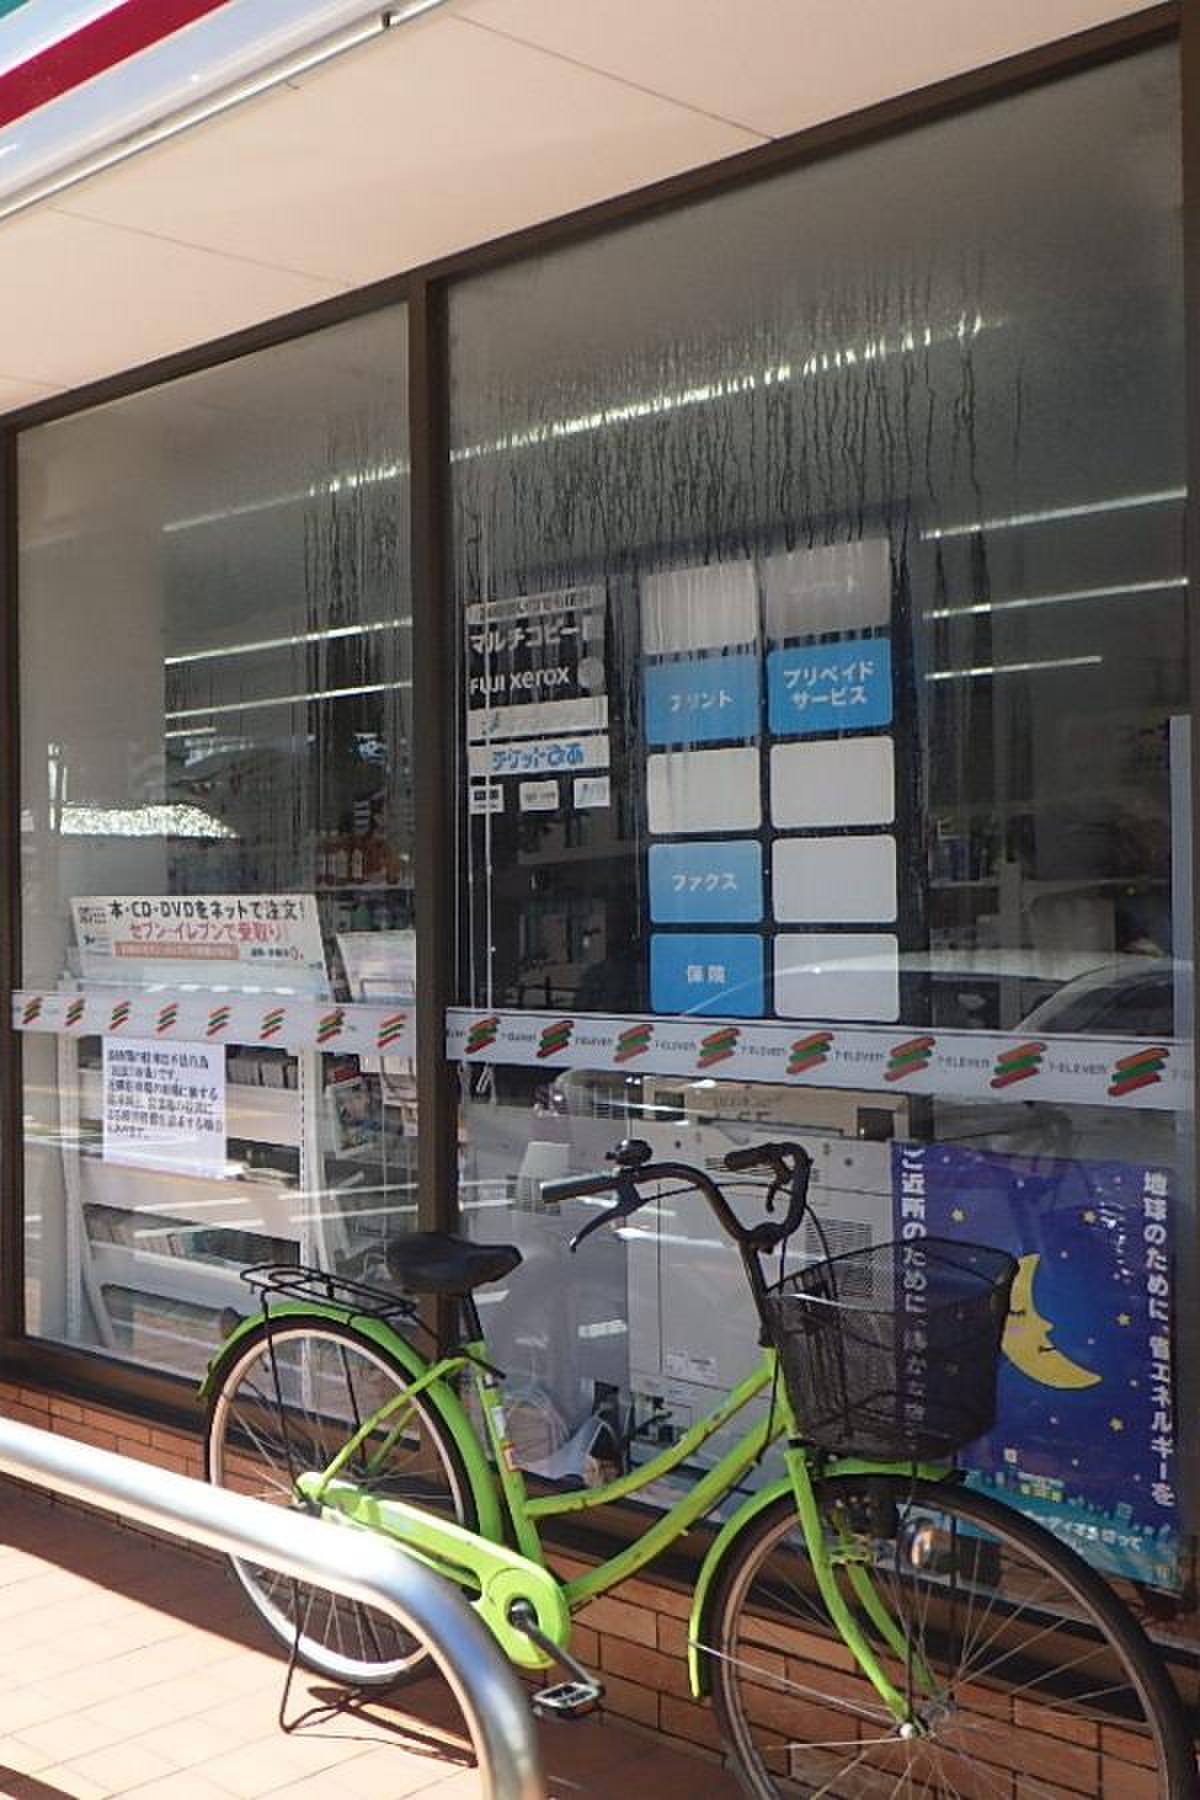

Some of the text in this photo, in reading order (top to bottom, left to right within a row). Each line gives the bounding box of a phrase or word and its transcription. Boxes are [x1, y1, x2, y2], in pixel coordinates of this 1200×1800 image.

[470, 618, 579, 654] マルチコピー
[469, 675, 506, 695] FUJI
[784, 661, 875, 689] プリペイド
[671, 690, 734, 712] プリント
[793, 686, 868, 710] サービス
[671, 872, 737, 892] ファクス
